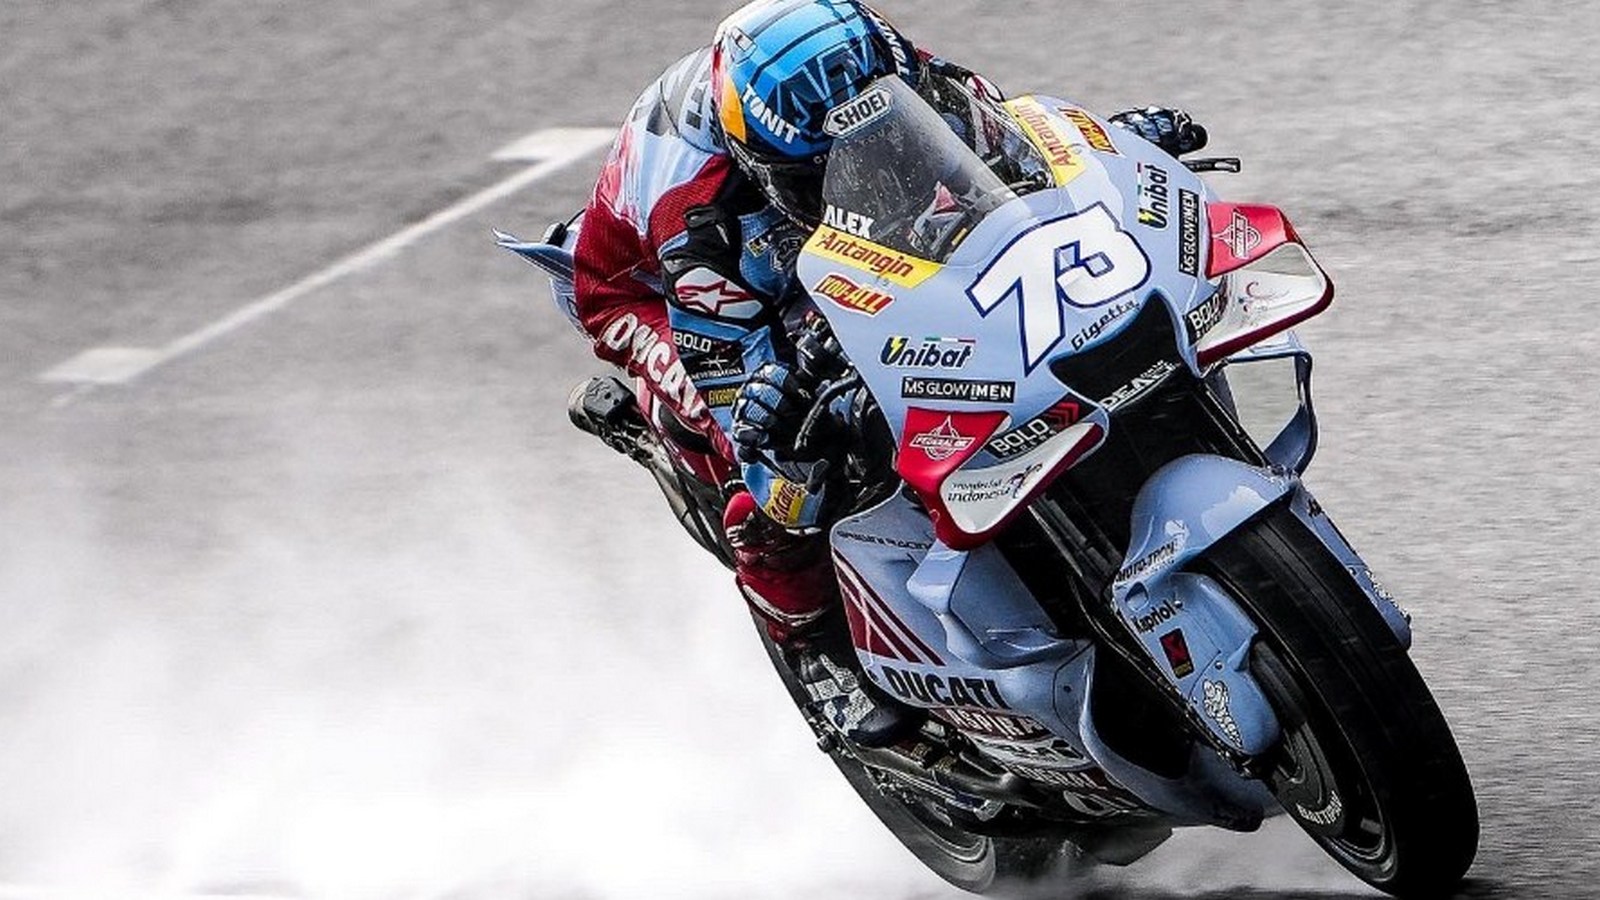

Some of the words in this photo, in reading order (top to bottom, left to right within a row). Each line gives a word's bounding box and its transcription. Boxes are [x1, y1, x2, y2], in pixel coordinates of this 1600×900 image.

[742, 83, 800, 144] TONIT
[832, 91, 886, 131] SHOEI
[1138, 164, 1168, 229] Unibat
[823, 205, 875, 239] ALEX
[817, 231, 914, 278] Antangin
[965, 201, 1152, 377] 73
[1188, 292, 1220, 330] BOLD
[671, 330, 712, 353] BOLD
[879, 335, 973, 369] Unibat
[990, 418, 1050, 453] BOLD
[881, 665, 1012, 710] DUCATI
